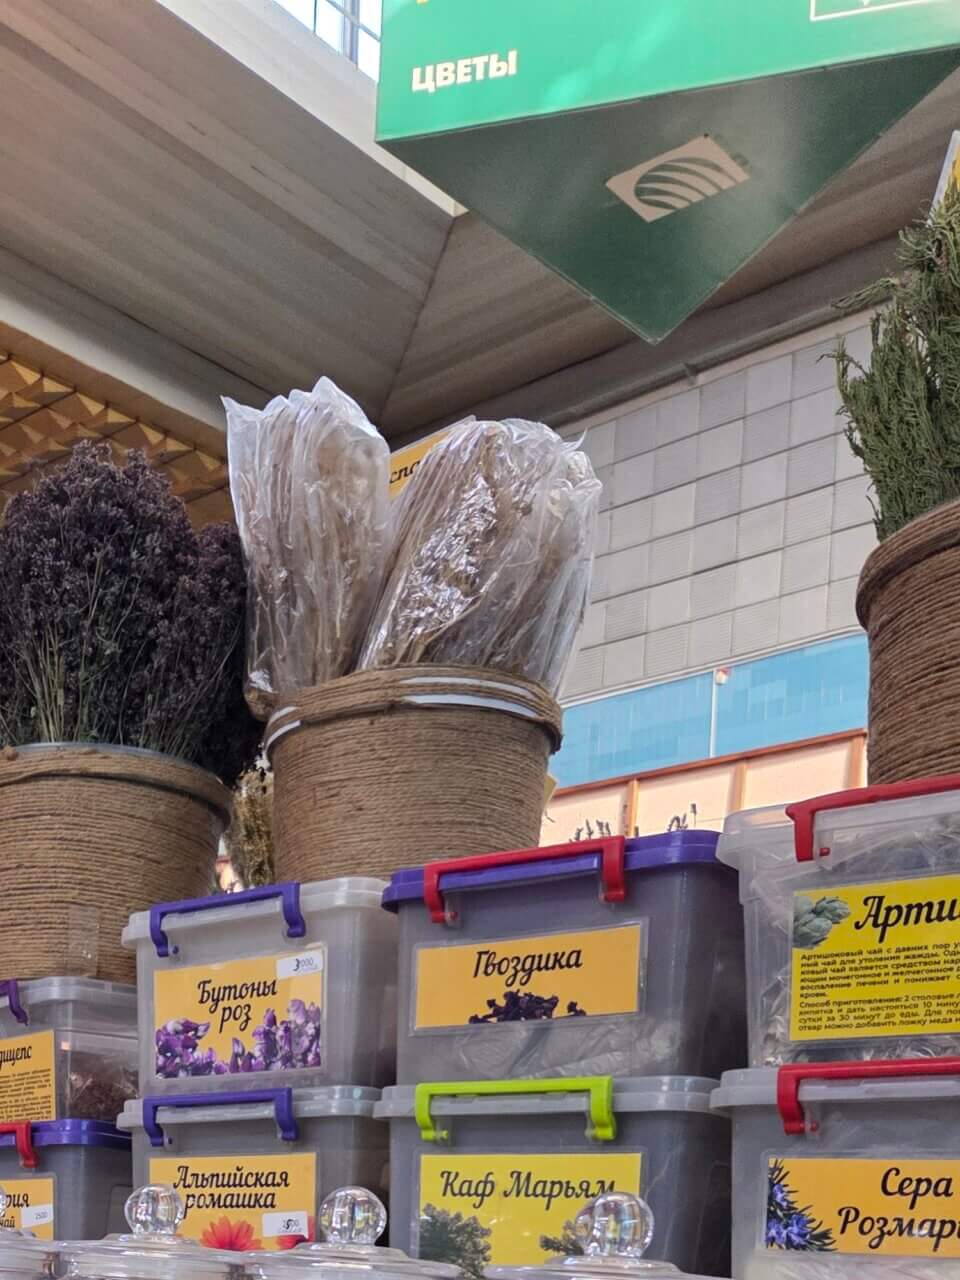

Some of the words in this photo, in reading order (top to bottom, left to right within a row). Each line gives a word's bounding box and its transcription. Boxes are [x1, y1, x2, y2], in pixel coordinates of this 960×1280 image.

[411, 50, 518, 92] ЦВЕТЫ
[473, 949, 583, 987] Гвоздика
[197, 979, 277, 1014] Бутоны
[219, 1003, 251, 1034] роз
[173, 1165, 289, 1189] Альпийская
[440, 1170, 496, 1209] Каф
[503, 1170, 616, 1211] Марьям
[881, 1167, 954, 1210] Сера
[183, 1192, 276, 1219] ромашка
[837, 1206, 960, 1252] Розмар
